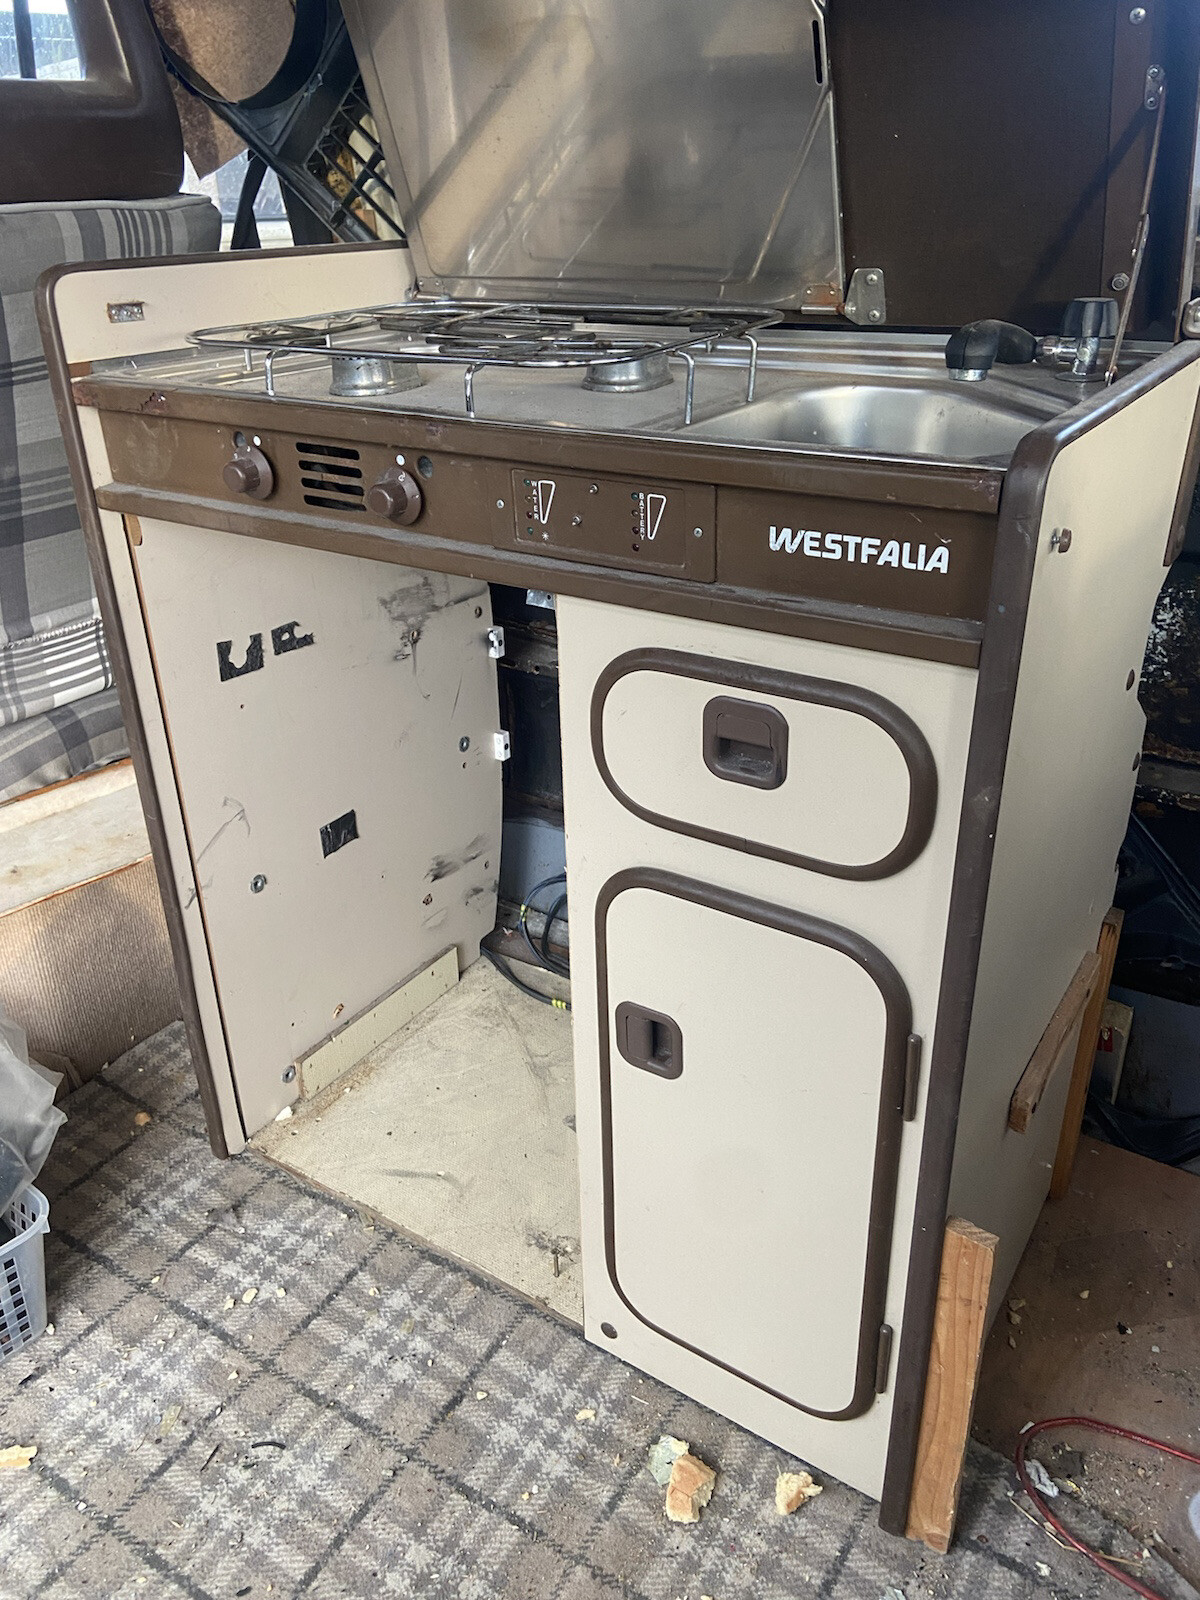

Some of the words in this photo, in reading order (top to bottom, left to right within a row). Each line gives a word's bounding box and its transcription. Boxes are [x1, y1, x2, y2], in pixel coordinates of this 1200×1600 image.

[530, 480, 540, 521] WATER
[637, 492, 646, 541] BATTERY
[769, 526, 950, 574] WESTFALIA
